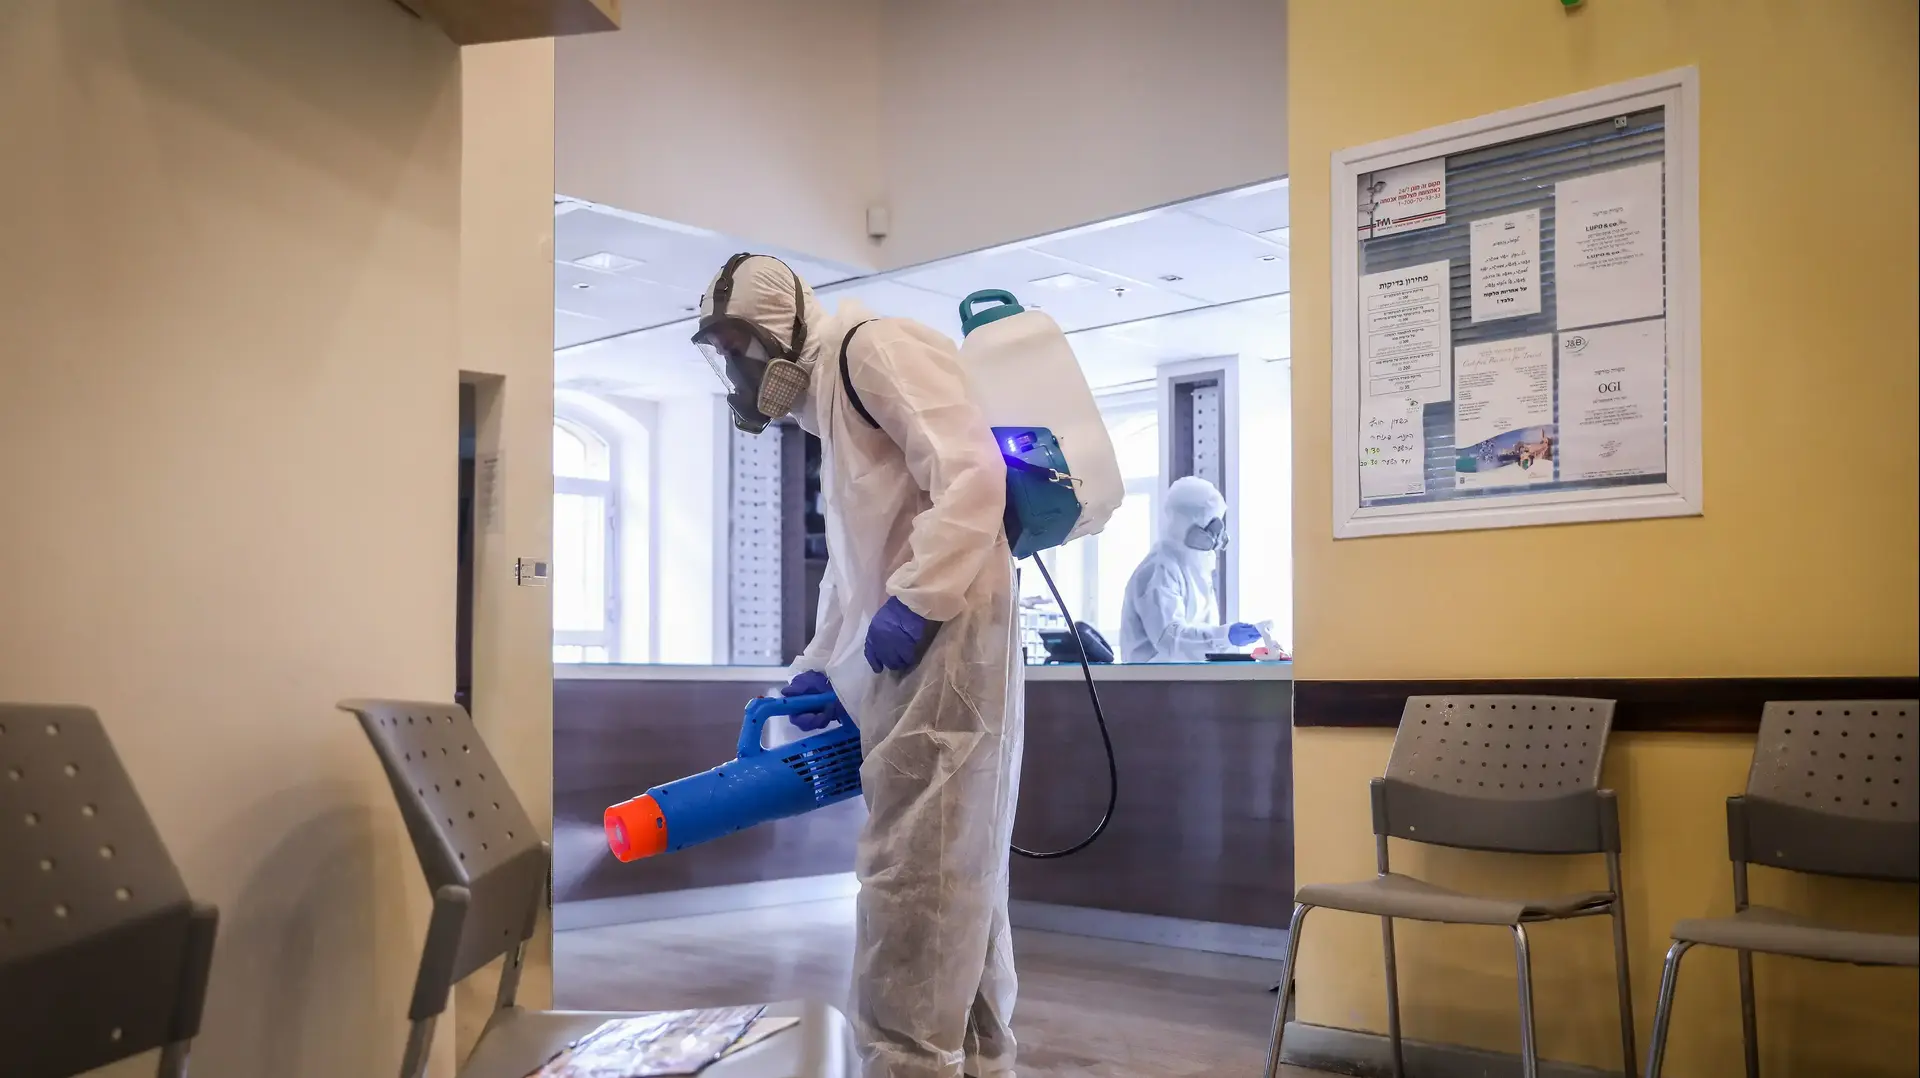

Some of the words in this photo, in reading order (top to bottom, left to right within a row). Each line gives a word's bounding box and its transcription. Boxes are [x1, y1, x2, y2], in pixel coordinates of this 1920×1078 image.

[1586, 223, 1603, 232] LUPO
[1379, 279, 1404, 290] בדיקות
[1405, 275, 1428, 286] מחירון
[1598, 381, 1621, 393] OGI
